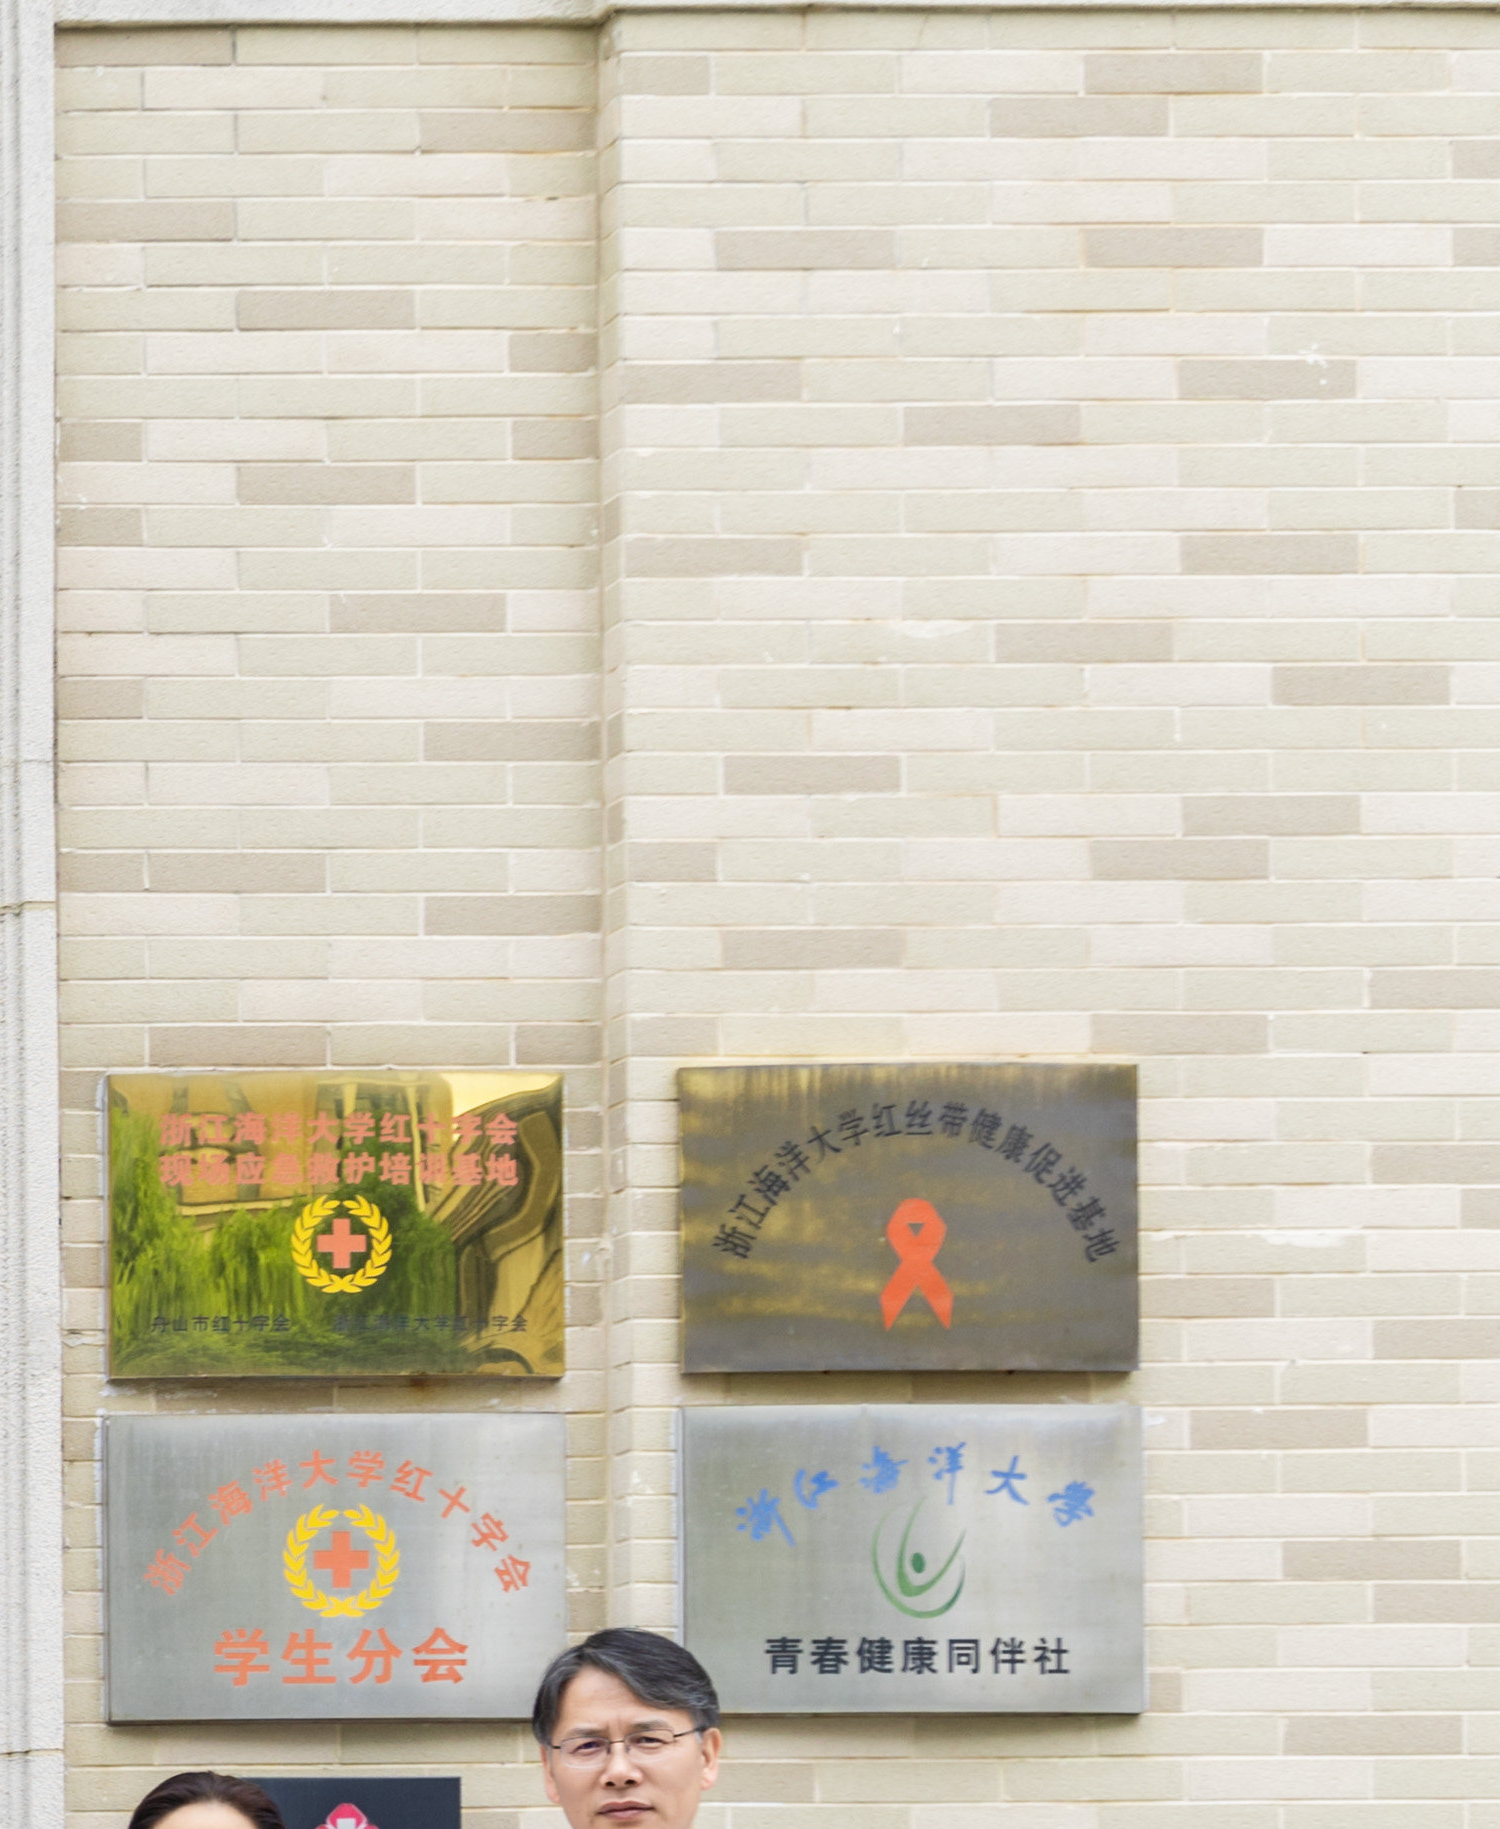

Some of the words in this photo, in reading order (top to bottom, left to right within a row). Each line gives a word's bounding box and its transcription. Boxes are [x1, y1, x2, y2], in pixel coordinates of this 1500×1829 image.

[160, 1112, 518, 1146] 浙江海洋大学红十字会
[159, 1152, 519, 1186] 现场应急救护培训基地
[712, 1100, 1120, 1263] 浙江海洋大学红丝带健康促进基地
[151, 1313, 291, 1333] 舟山市红十字会
[735, 1442, 1094, 1547] 浙江海洋大学
[143, 1449, 531, 1595] 浙江海洋大学红十字会
[213, 1627, 468, 1687] 学生分会
[764, 1636, 1070, 1675] 青春健康同伴社
